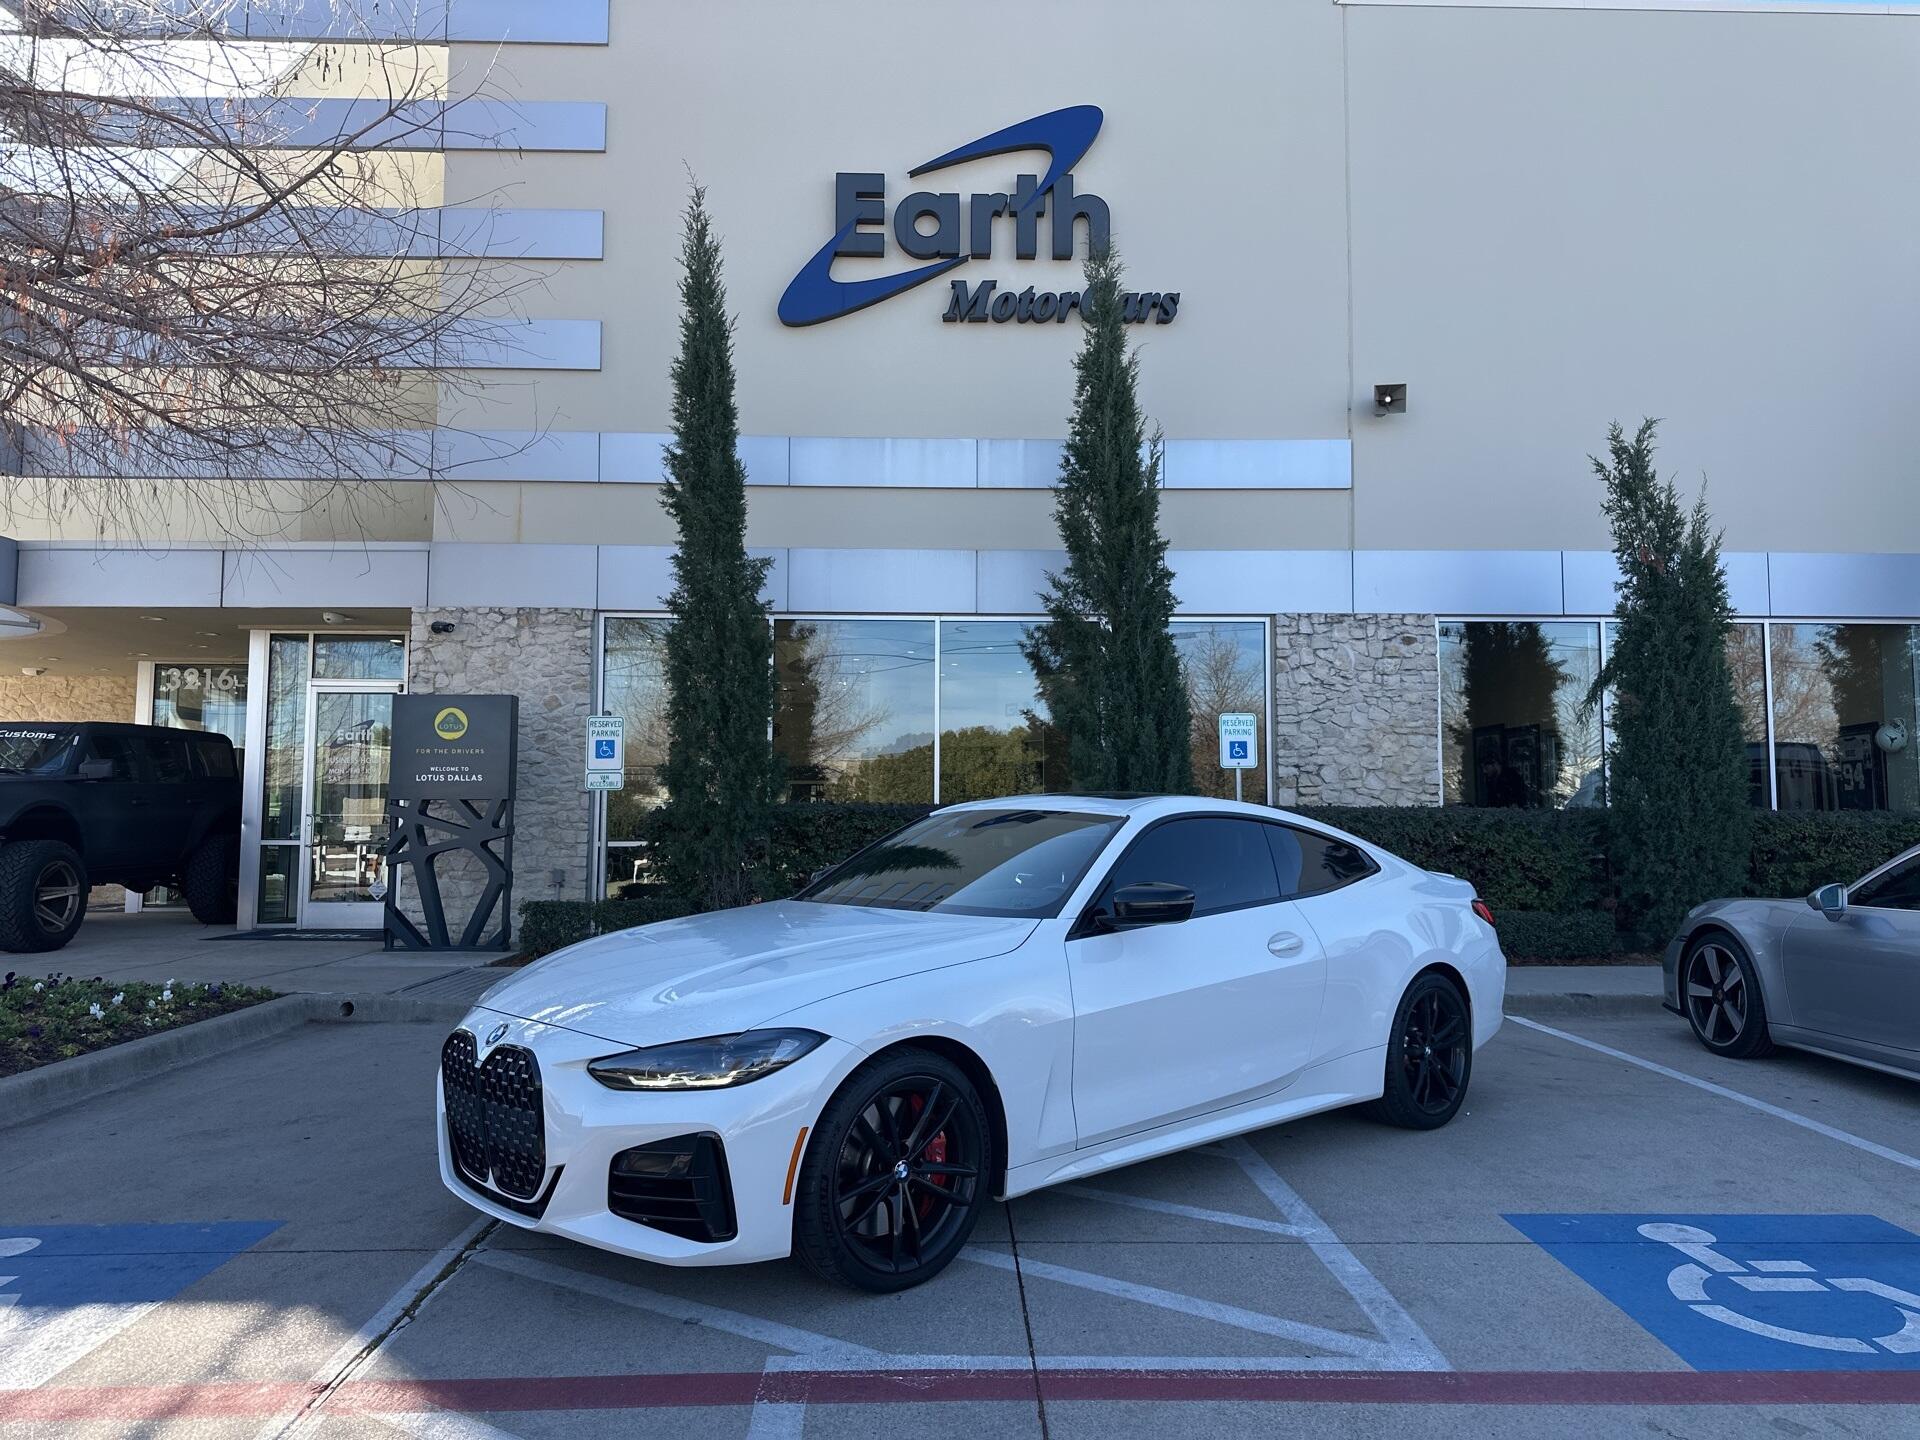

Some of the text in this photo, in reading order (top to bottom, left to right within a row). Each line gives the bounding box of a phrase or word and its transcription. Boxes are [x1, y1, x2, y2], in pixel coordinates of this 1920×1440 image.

[835, 172, 1111, 260] Earth
[337, 729, 374, 741] Earth
[1224, 728, 1252, 736] PARKING
[415, 774, 484, 782] LOTUS DALLAS
